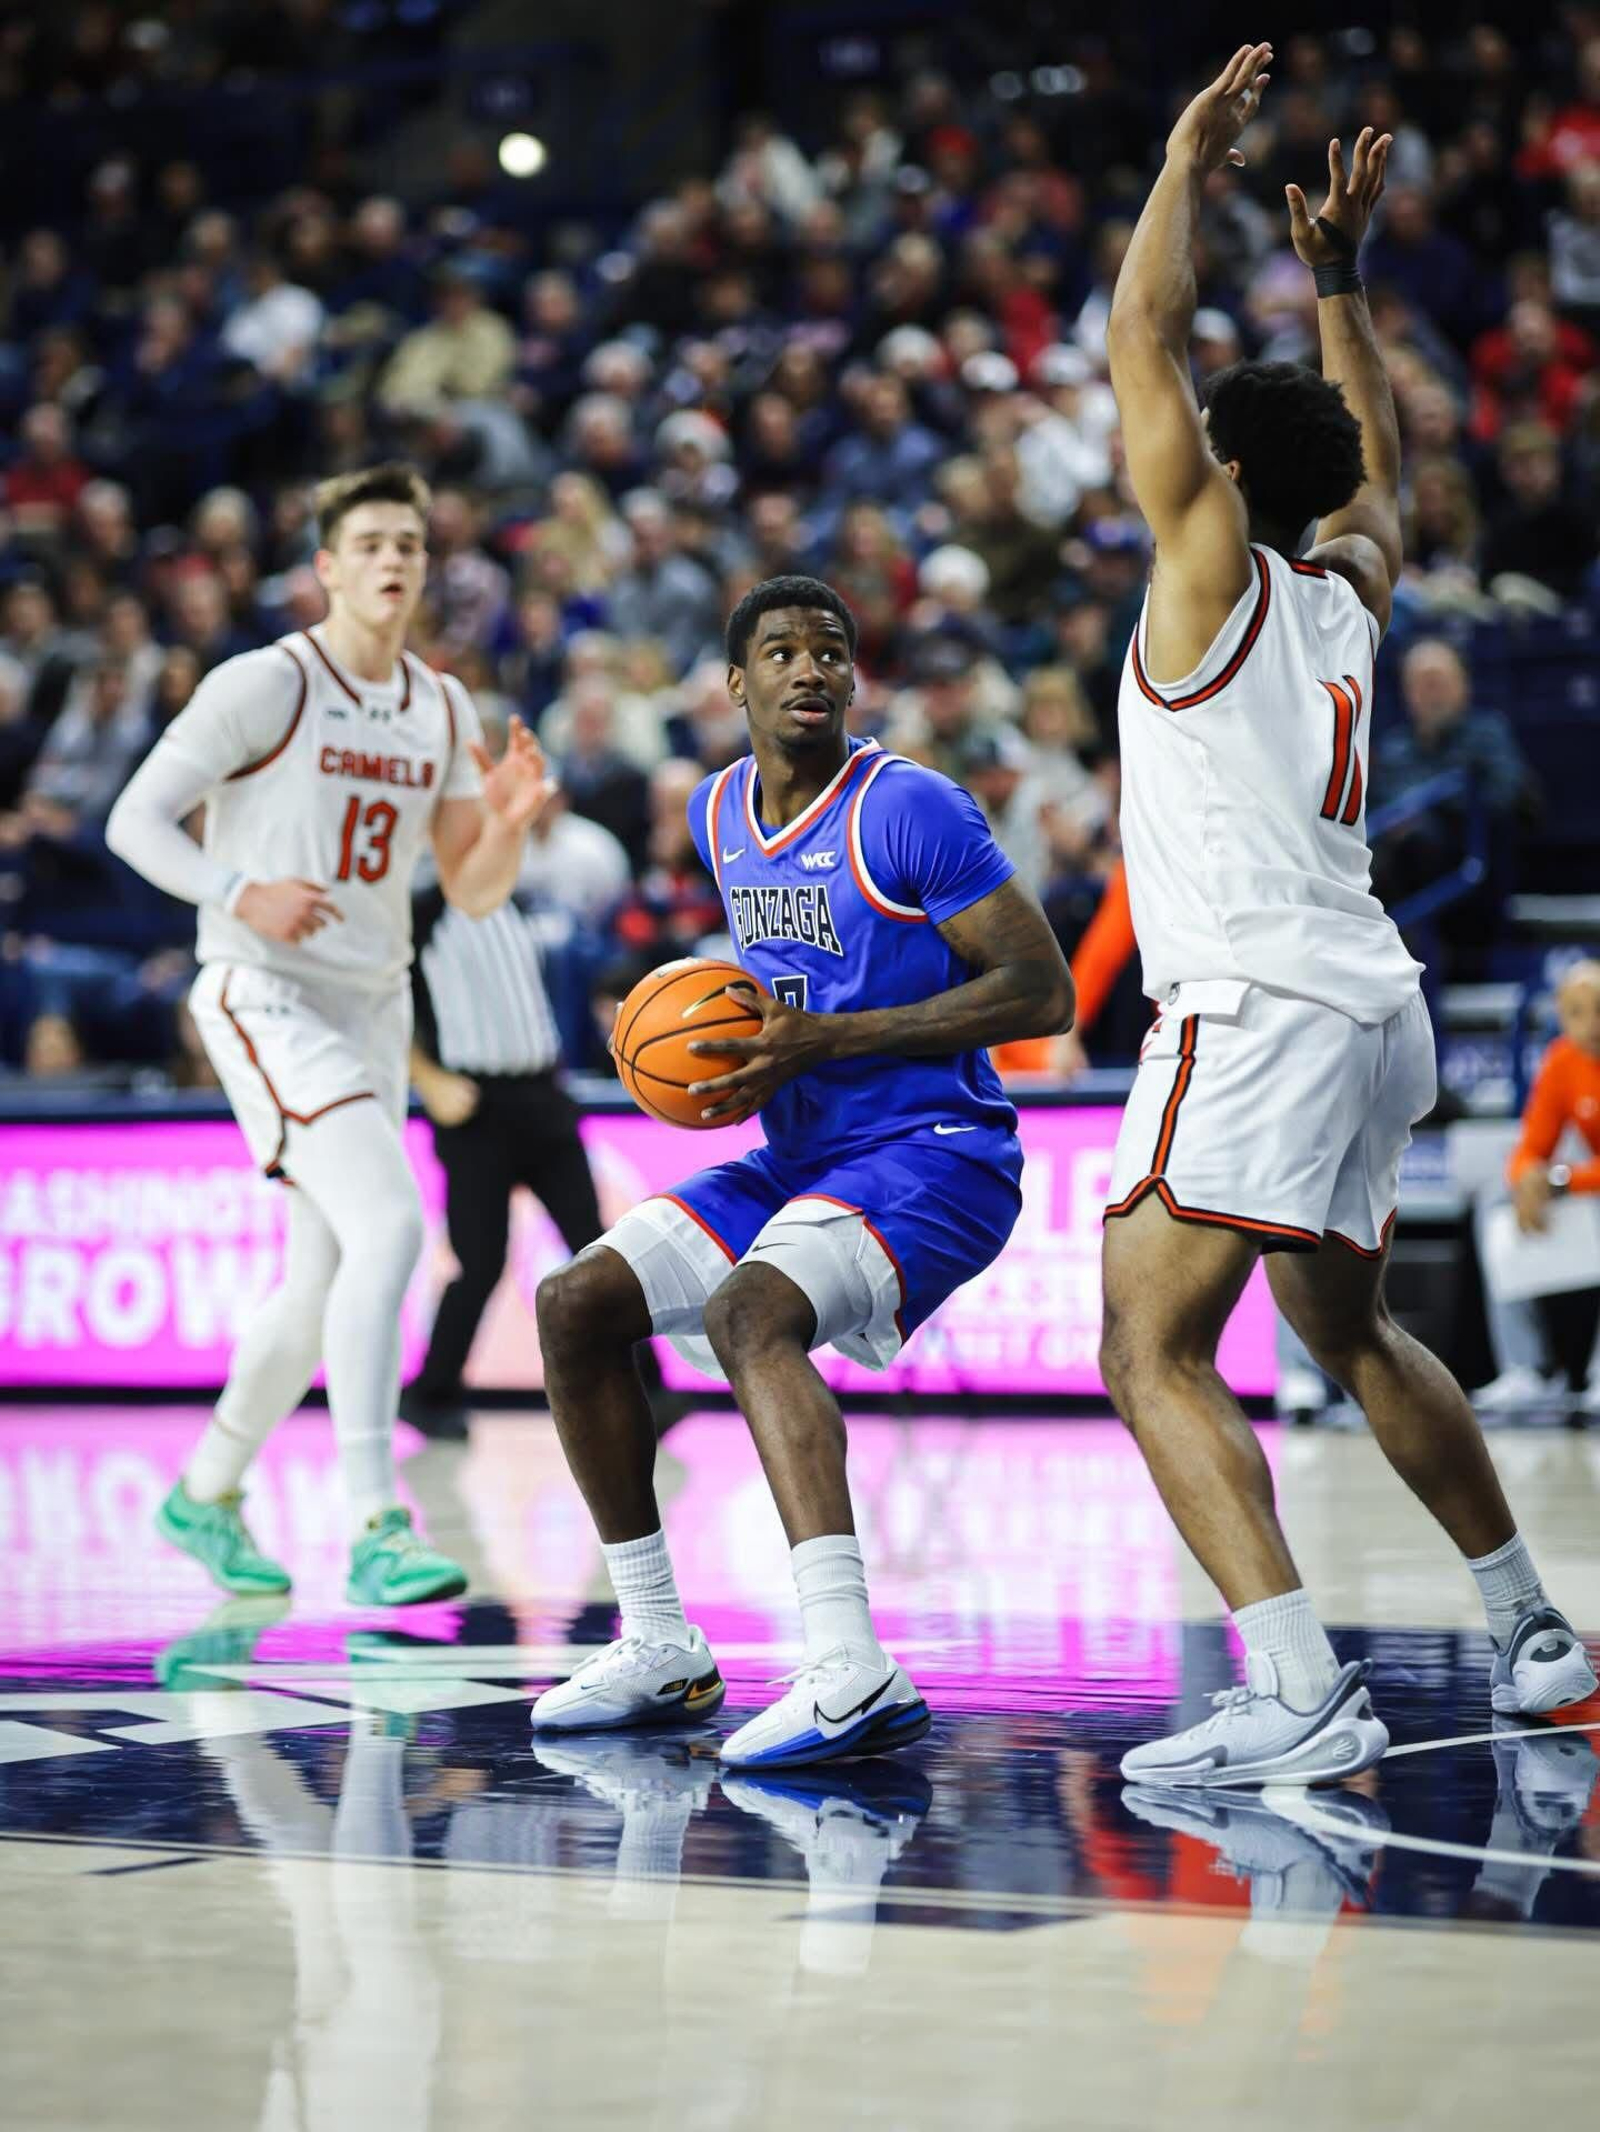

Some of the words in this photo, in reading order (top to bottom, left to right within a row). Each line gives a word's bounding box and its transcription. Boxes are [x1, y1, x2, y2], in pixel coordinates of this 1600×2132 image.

[319, 746, 435, 789] CAMELS
[1316, 674, 1363, 826] 11
[336, 794, 398, 884] 13
[800, 850, 836, 871] WCC
[729, 884, 844, 957] GONZAGA
